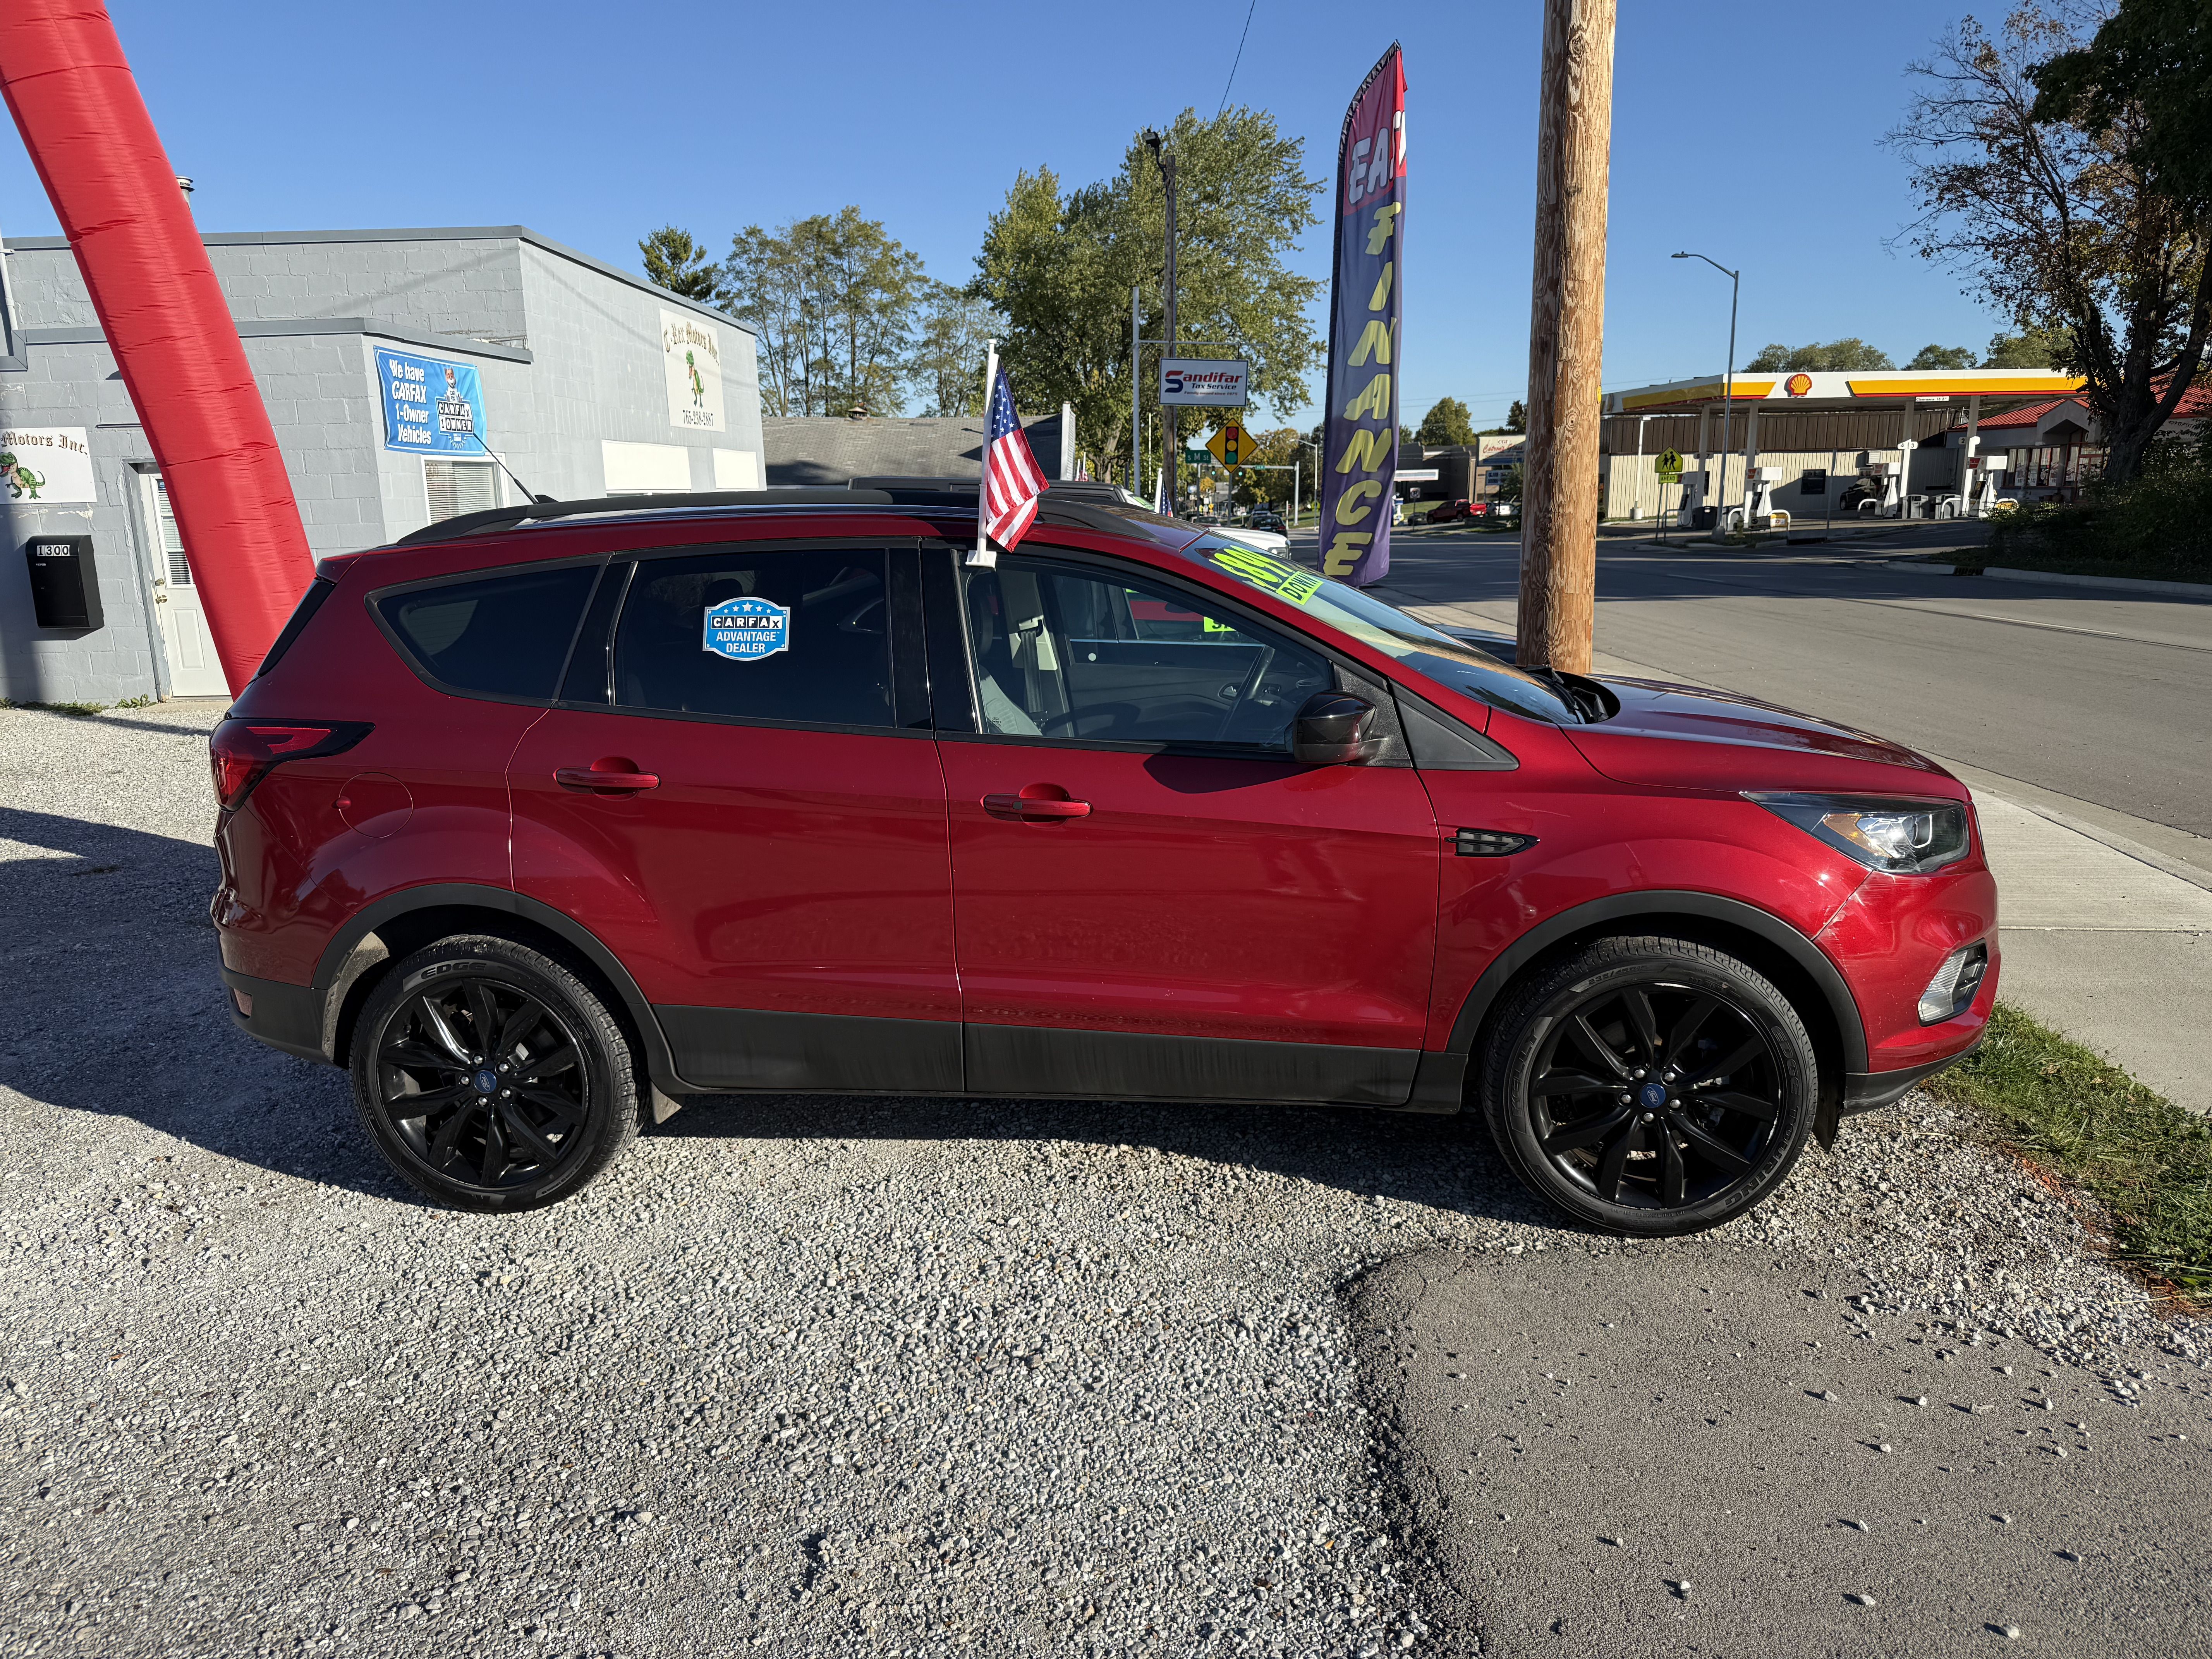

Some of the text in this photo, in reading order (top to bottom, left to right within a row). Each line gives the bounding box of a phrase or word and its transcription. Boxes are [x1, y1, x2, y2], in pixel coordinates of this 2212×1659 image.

[686, 321, 707, 350] Motors
[389, 359, 424, 382] We have
[1164, 370, 1243, 393] Sandifar
[392, 381, 426, 403] CARFAX
[1323, 202, 1401, 576] FINANCE
[396, 403, 429, 423] 1-Owner
[438, 402, 470, 417] CARFAX
[398, 424, 431, 444] Vehicles
[446, 419, 472, 431] OWNER
[0, 431, 88, 455] Motors Inc.
[38, 545, 69, 555] 1300
[1281, 572, 1320, 601] DOWN
[713, 617, 780, 628] CARFAX
[716, 631, 776, 641] ADVANTAGE
[726, 643, 765, 653] DEALER
[421, 962, 487, 979] EDGE
[1511, 1026, 1539, 1117] KELLY
[1771, 1025, 1800, 1096] EDGE
[1725, 1106, 1799, 1206] TOURING
